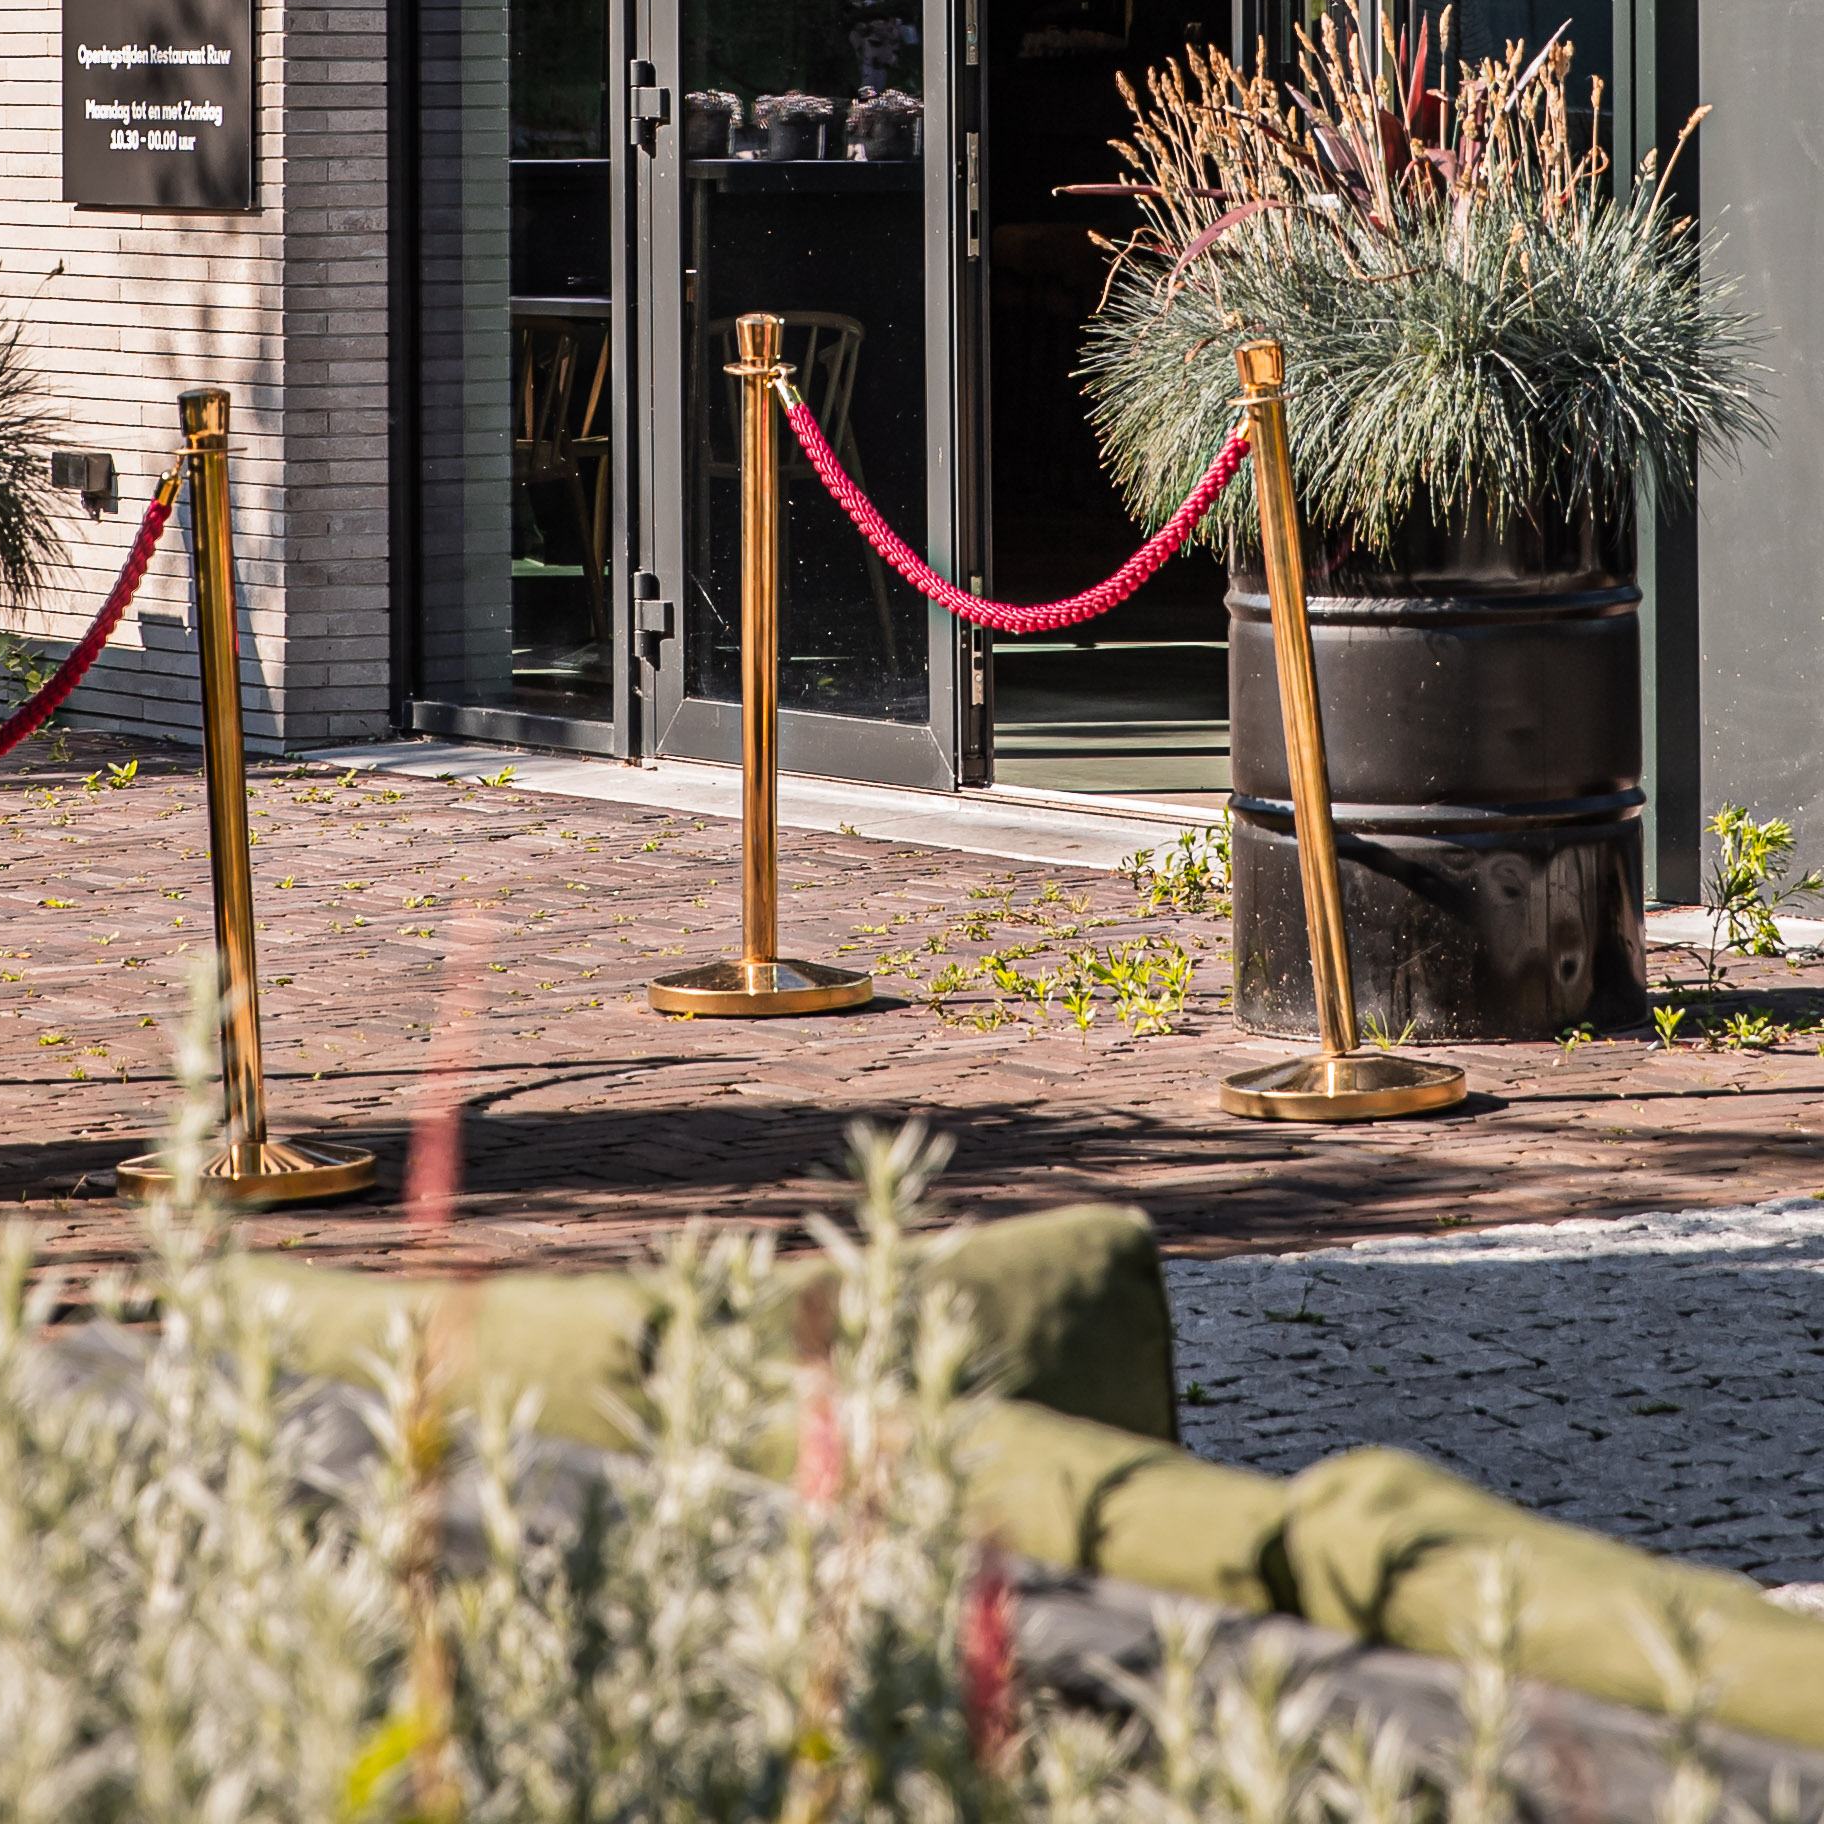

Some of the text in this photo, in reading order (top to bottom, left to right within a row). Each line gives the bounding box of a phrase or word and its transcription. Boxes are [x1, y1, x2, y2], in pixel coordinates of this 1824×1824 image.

[78, 43, 232, 70] Openingstijden Restaurant Ruw
[85, 98, 223, 126] Maandag tot en met Zondag
[109, 129, 139, 150] 10.30
[147, 129, 177, 151] 00.00
[178, 135, 196, 151] uur
